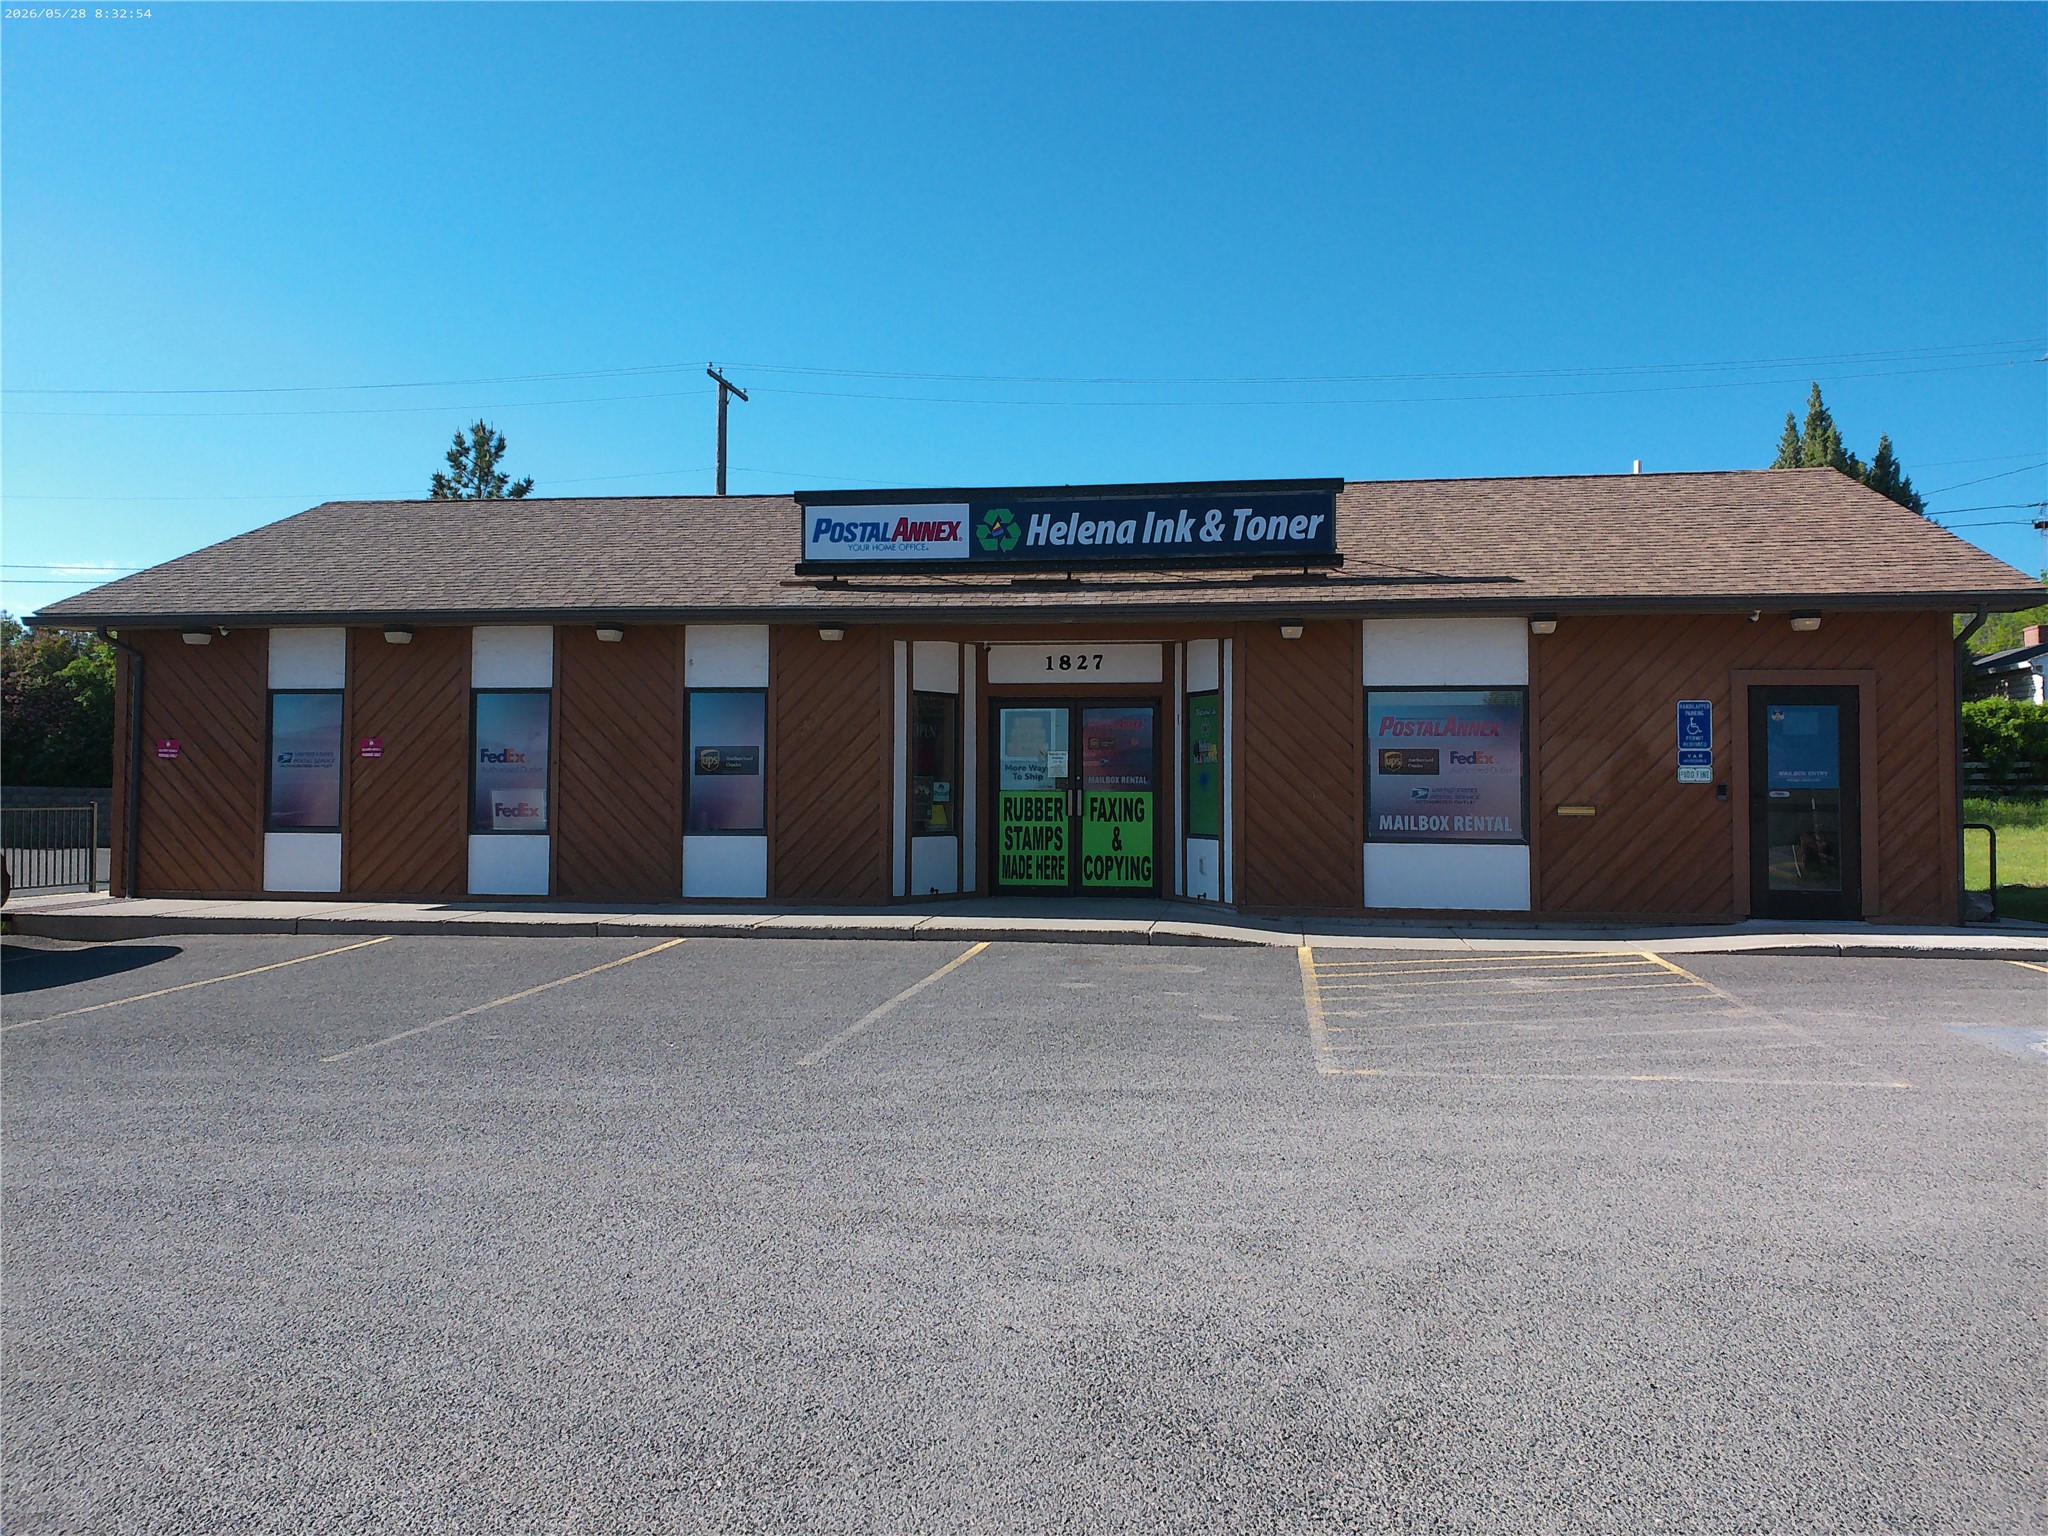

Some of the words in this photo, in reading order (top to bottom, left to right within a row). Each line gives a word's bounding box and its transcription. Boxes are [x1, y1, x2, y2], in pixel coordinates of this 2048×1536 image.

[1026, 511, 1138, 547] Helena
[1142, 508, 1197, 544] Ink
[1199, 507, 1226, 543] &
[1233, 507, 1325, 542] Toner
[848, 543, 870, 552] YOUR
[872, 543, 896, 551] HOME
[1045, 654, 1103, 671] 1827
[480, 748, 526, 763] FedEx
[1449, 750, 1495, 765] FedEx
[1004, 763, 1027, 772] More
[1012, 772, 1023, 780] To
[1024, 772, 1044, 782] Ship
[1087, 775, 1120, 784] MAILBOX
[1120, 775, 1148, 784] RENTAL
[495, 802, 540, 817] FedEx
[1003, 797, 1064, 822] RUBBER
[1090, 797, 1145, 823] FAXING
[1379, 814, 1450, 832] MAILBOX
[1453, 815, 1513, 832] RENTAL
[1004, 826, 1063, 852] STAMPS
[1111, 826, 1122, 852] &
[1002, 855, 1032, 880] MADE
[1036, 855, 1065, 880] HERE
[1083, 855, 1152, 881] COPYING
